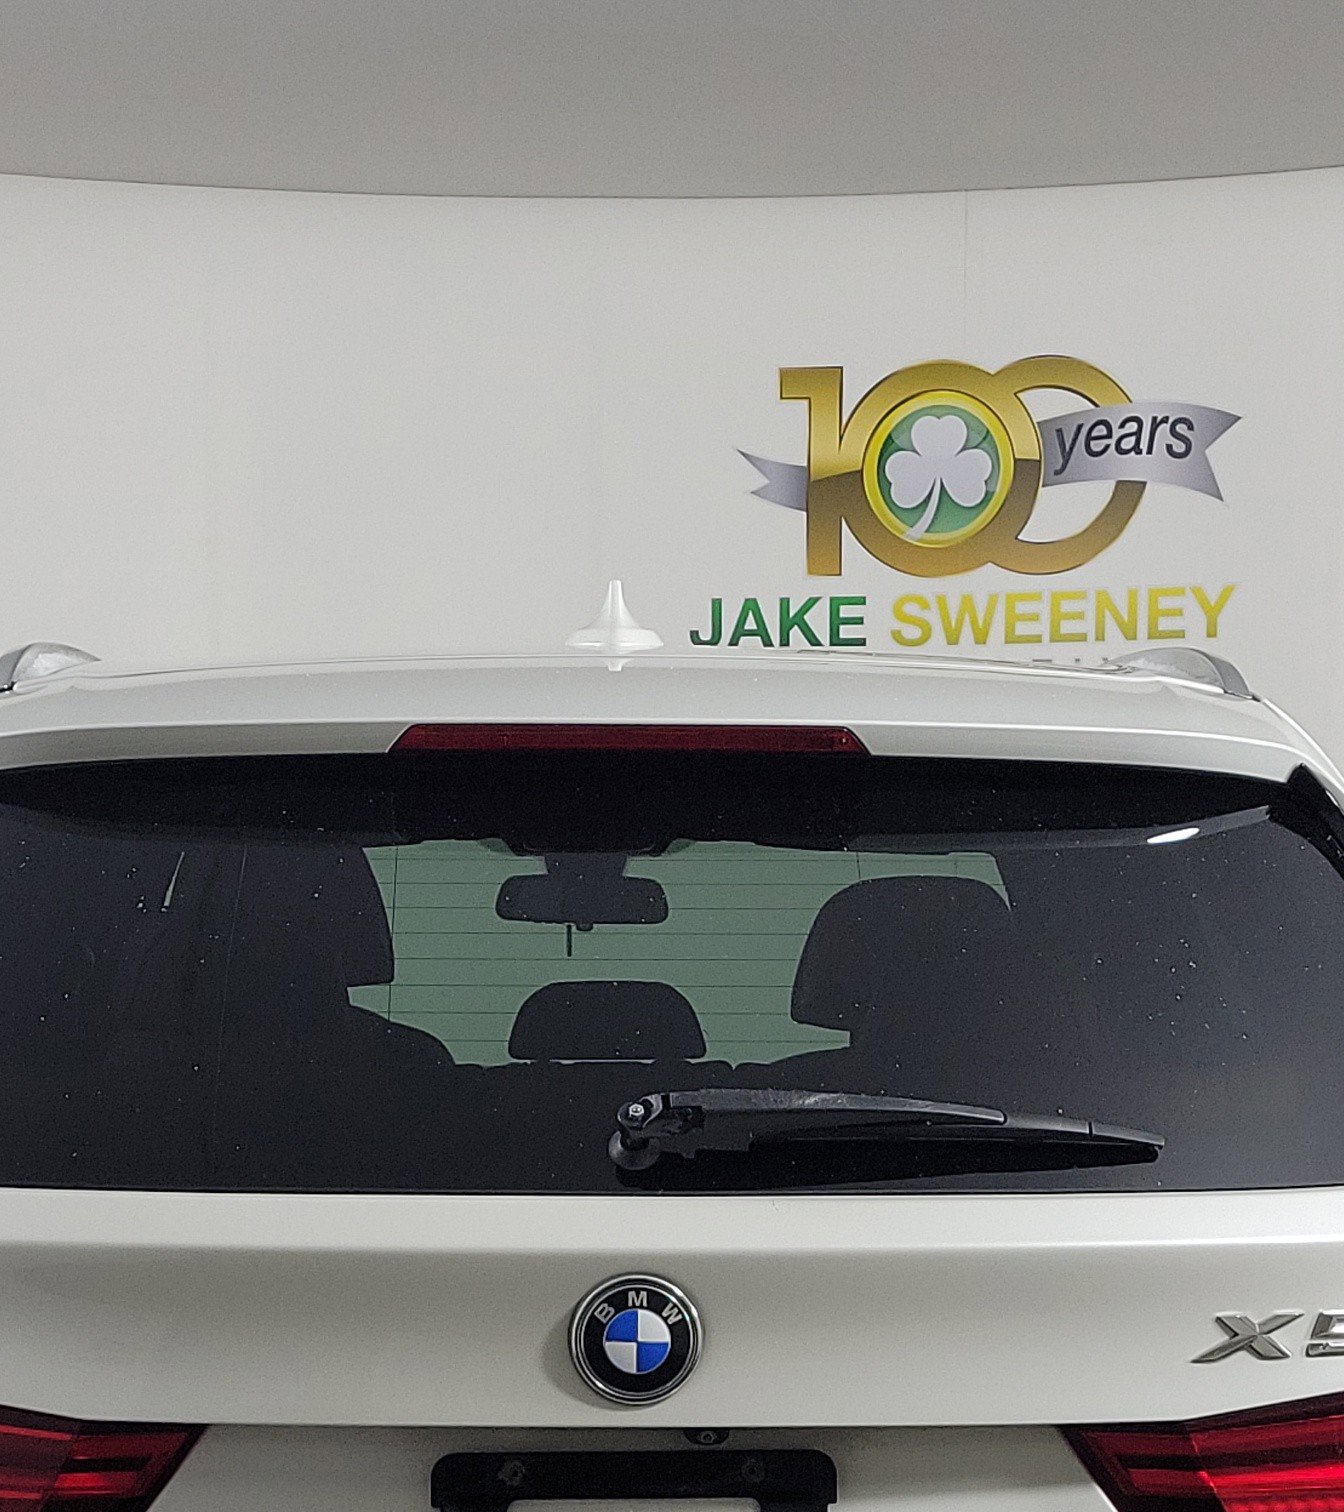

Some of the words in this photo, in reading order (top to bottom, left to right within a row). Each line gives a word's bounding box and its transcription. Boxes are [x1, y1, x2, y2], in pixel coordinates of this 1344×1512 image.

[778, 354, 1147, 578] 100
[1053, 413, 1195, 476] years
[689, 595, 867, 648] JAKE
[890, 585, 1236, 647] SWEENEY
[594, 1290, 683, 1325] BMW
